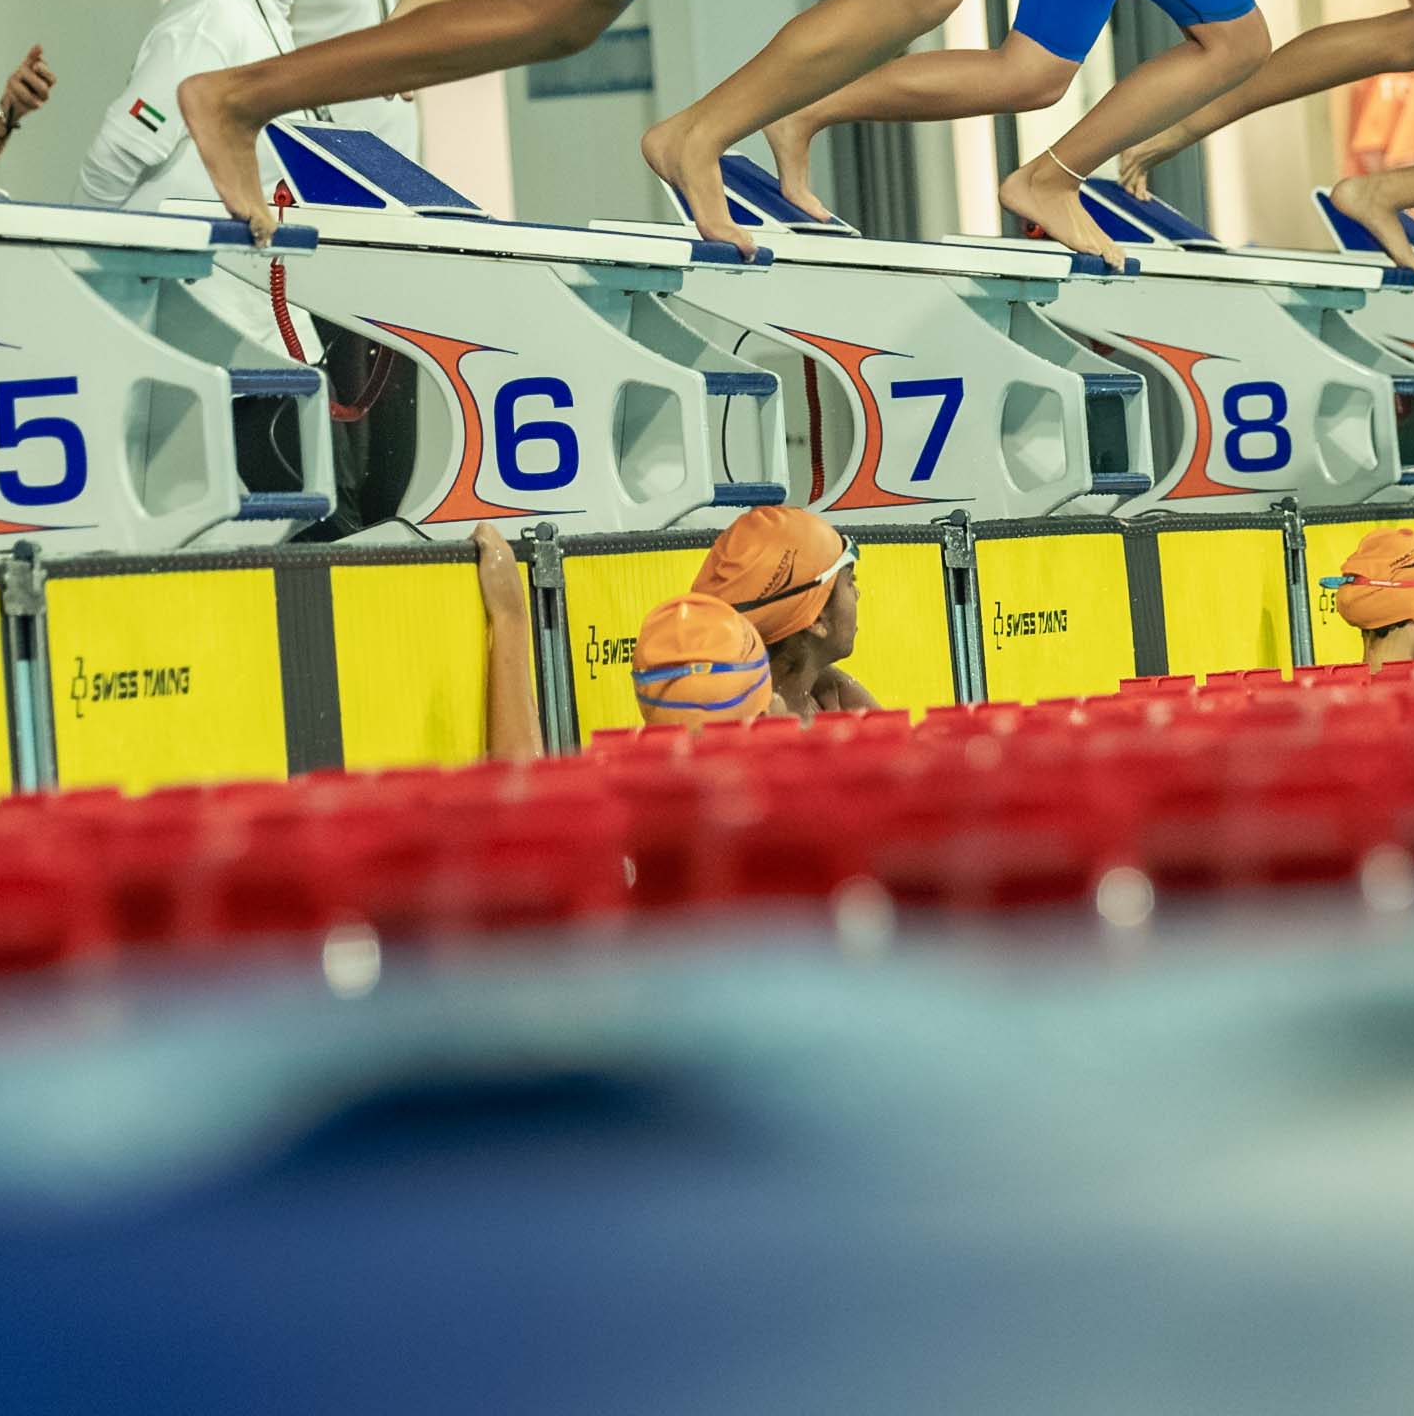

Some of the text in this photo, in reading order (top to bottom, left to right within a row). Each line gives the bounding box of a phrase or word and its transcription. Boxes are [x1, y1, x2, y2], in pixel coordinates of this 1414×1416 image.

[494, 376, 579, 492] 6
[890, 377, 964, 482] 7
[1222, 380, 1292, 473] 8
[1006, 609, 1068, 638] SWISS TIMING
[91, 666, 191, 702] SWISS TIMING
